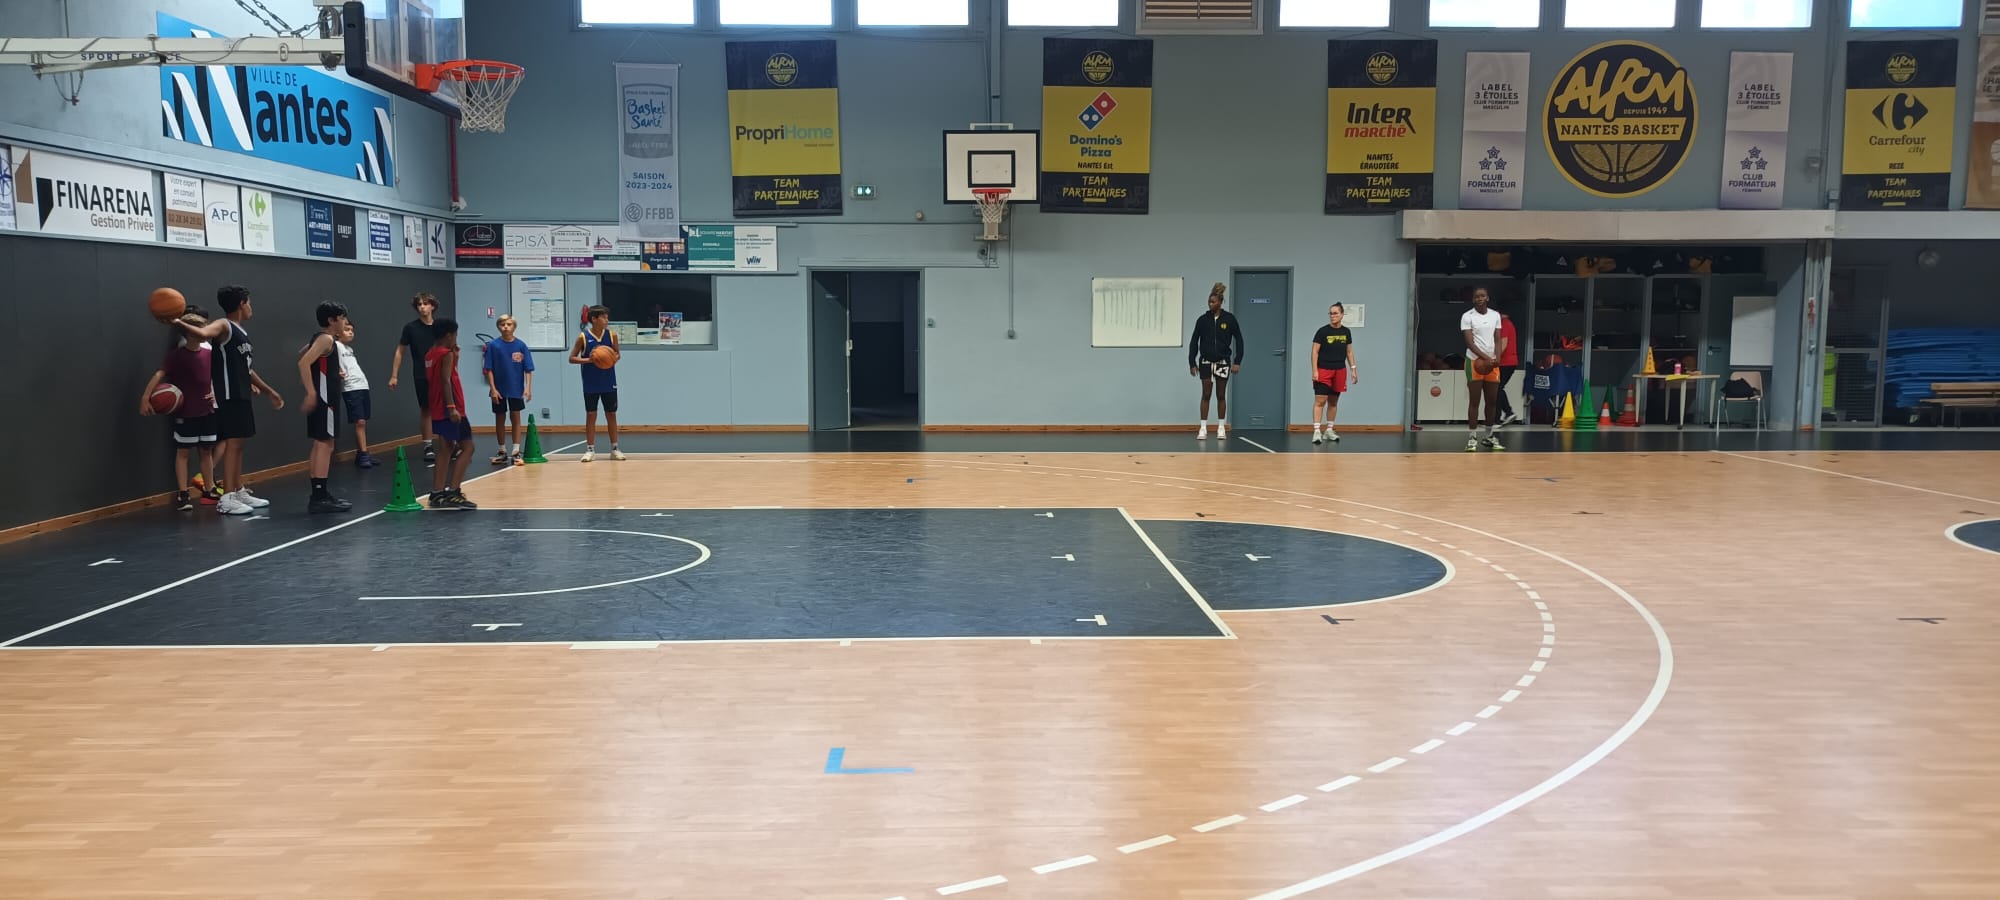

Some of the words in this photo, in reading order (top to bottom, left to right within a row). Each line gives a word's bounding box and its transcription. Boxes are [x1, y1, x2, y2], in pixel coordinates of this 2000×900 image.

[81, 52, 120, 62] SPORT
[251, 68, 281, 84] VILLE
[285, 71, 298, 87] DE
[1481, 83, 1513, 91] LABEL
[1554, 58, 1686, 120] ALPCM
[1744, 83, 1776, 92] LABEL
[1475, 92, 1481, 100] 3
[1483, 91, 1519, 100] ÉTOILES
[1737, 92, 1743, 100] 3
[1745, 91, 1781, 100] ÉTOILES
[627, 98, 667, 115] Basket
[1647, 106, 1669, 115] 1949
[631, 115, 663, 129] Santé
[735, 125, 834, 145] PropriHome
[1560, 124, 1620, 136] NANTES
[1622, 124, 1680, 136] BASKET
[1069, 134, 1123, 146] Domino's
[1868, 134, 1927, 146] Carrefour
[1080, 147, 1112, 157] Pizza
[1907, 145, 1926, 156] city
[1366, 153, 1393, 161] NANTES
[1077, 161, 1102, 169] NANTES
[633, 172, 665, 180] SAISON
[1082, 175, 1109, 185] TEAM
[1366, 176, 1393, 186] TEAM
[1481, 173, 1503, 181] CLUB
[1742, 173, 1763, 181] CLUB
[626, 181, 673, 190] 2023-2024
[773, 178, 800, 188] TEAM
[1467, 180, 1516, 189] FORMATEUR
[1728, 180, 1776, 188] FORMATEUR
[1885, 178, 1907, 186] TEAM
[754, 189, 819, 201] PARTENAIRES
[1062, 187, 1128, 199] PARTENAIRES
[1346, 188, 1411, 199] PARTENAIRES
[1867, 189, 1921, 199] PARTENAIRES
[56, 180, 153, 217] FINARENA
[211, 208, 238, 223] APC
[645, 207, 674, 220] FFBB
[90, 213, 126, 229] Gestion
[127, 217, 154, 231] Privée
